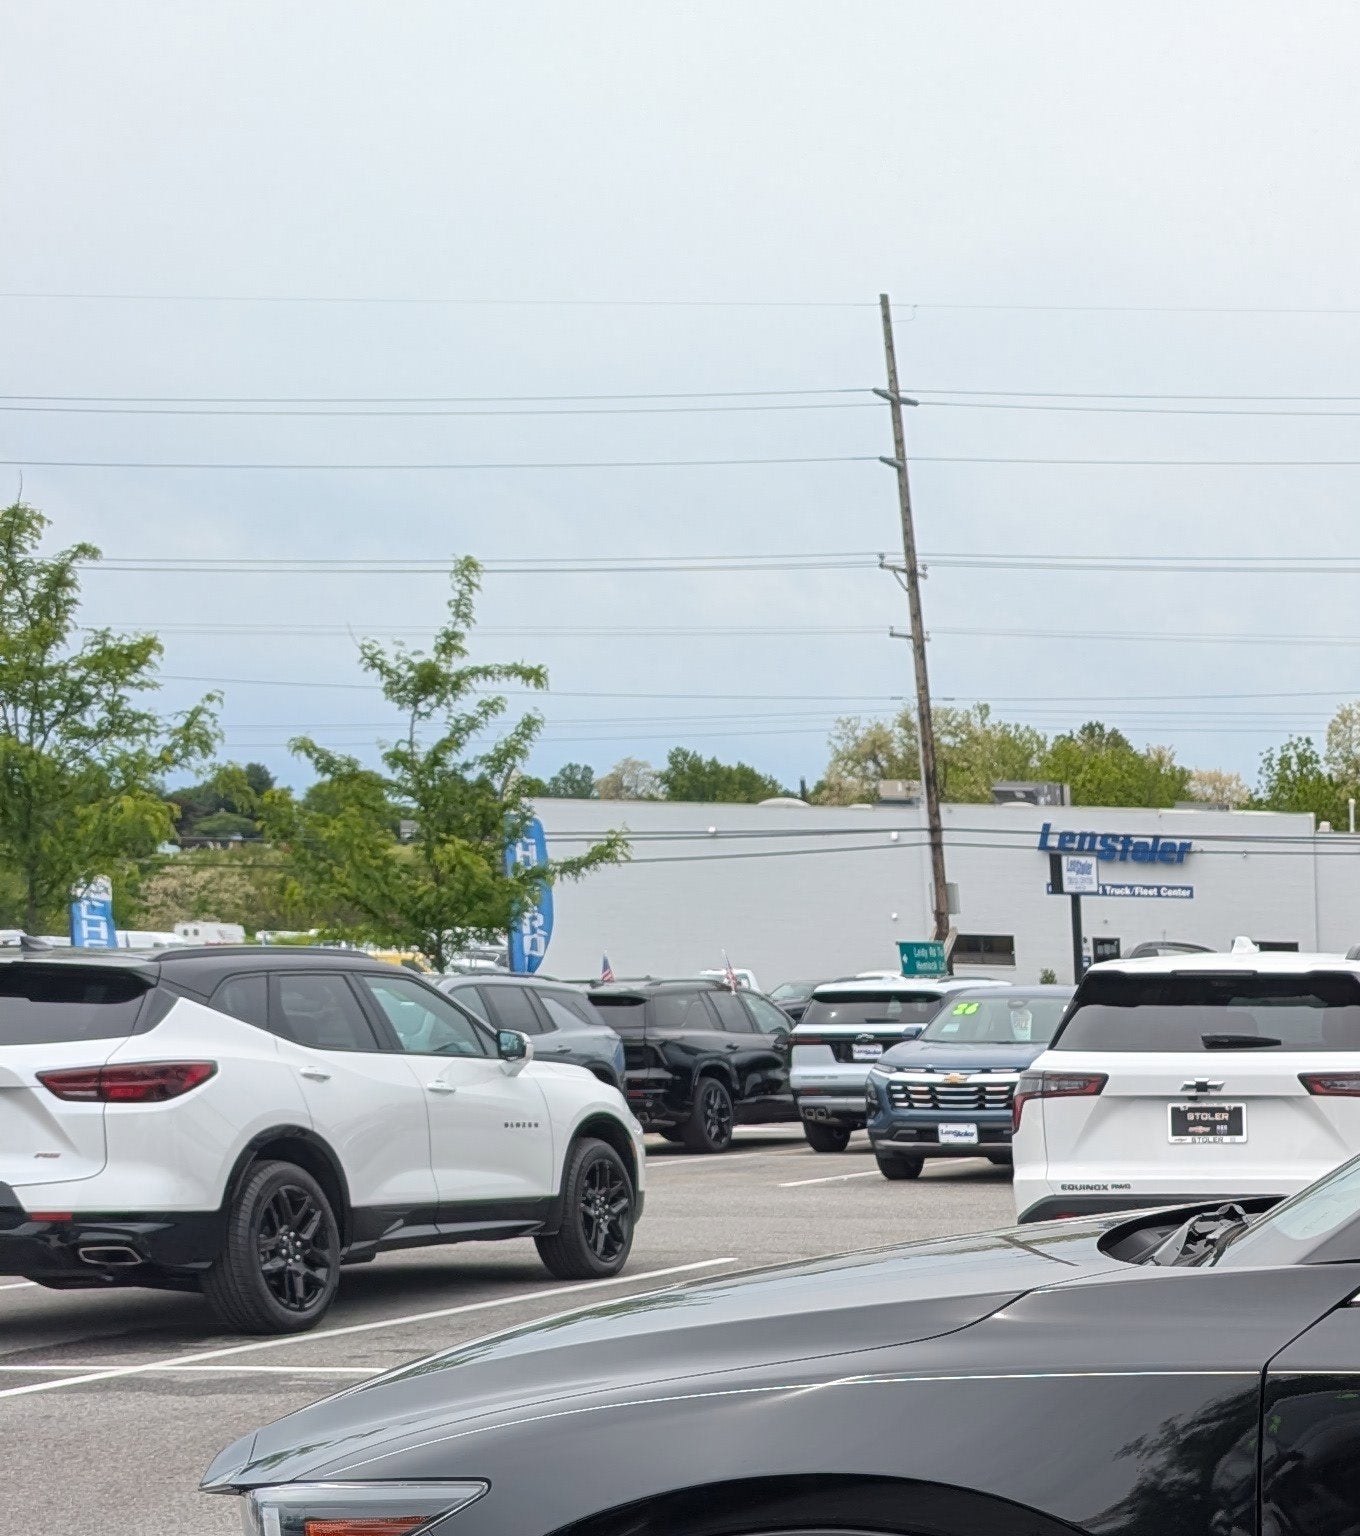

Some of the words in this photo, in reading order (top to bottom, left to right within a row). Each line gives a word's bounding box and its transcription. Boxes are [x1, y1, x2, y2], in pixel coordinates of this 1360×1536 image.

[1160, 887, 1191, 897] Center
[1187, 1112, 1229, 1121] STOLER
[1061, 1183, 1109, 1191] EQUINOX
